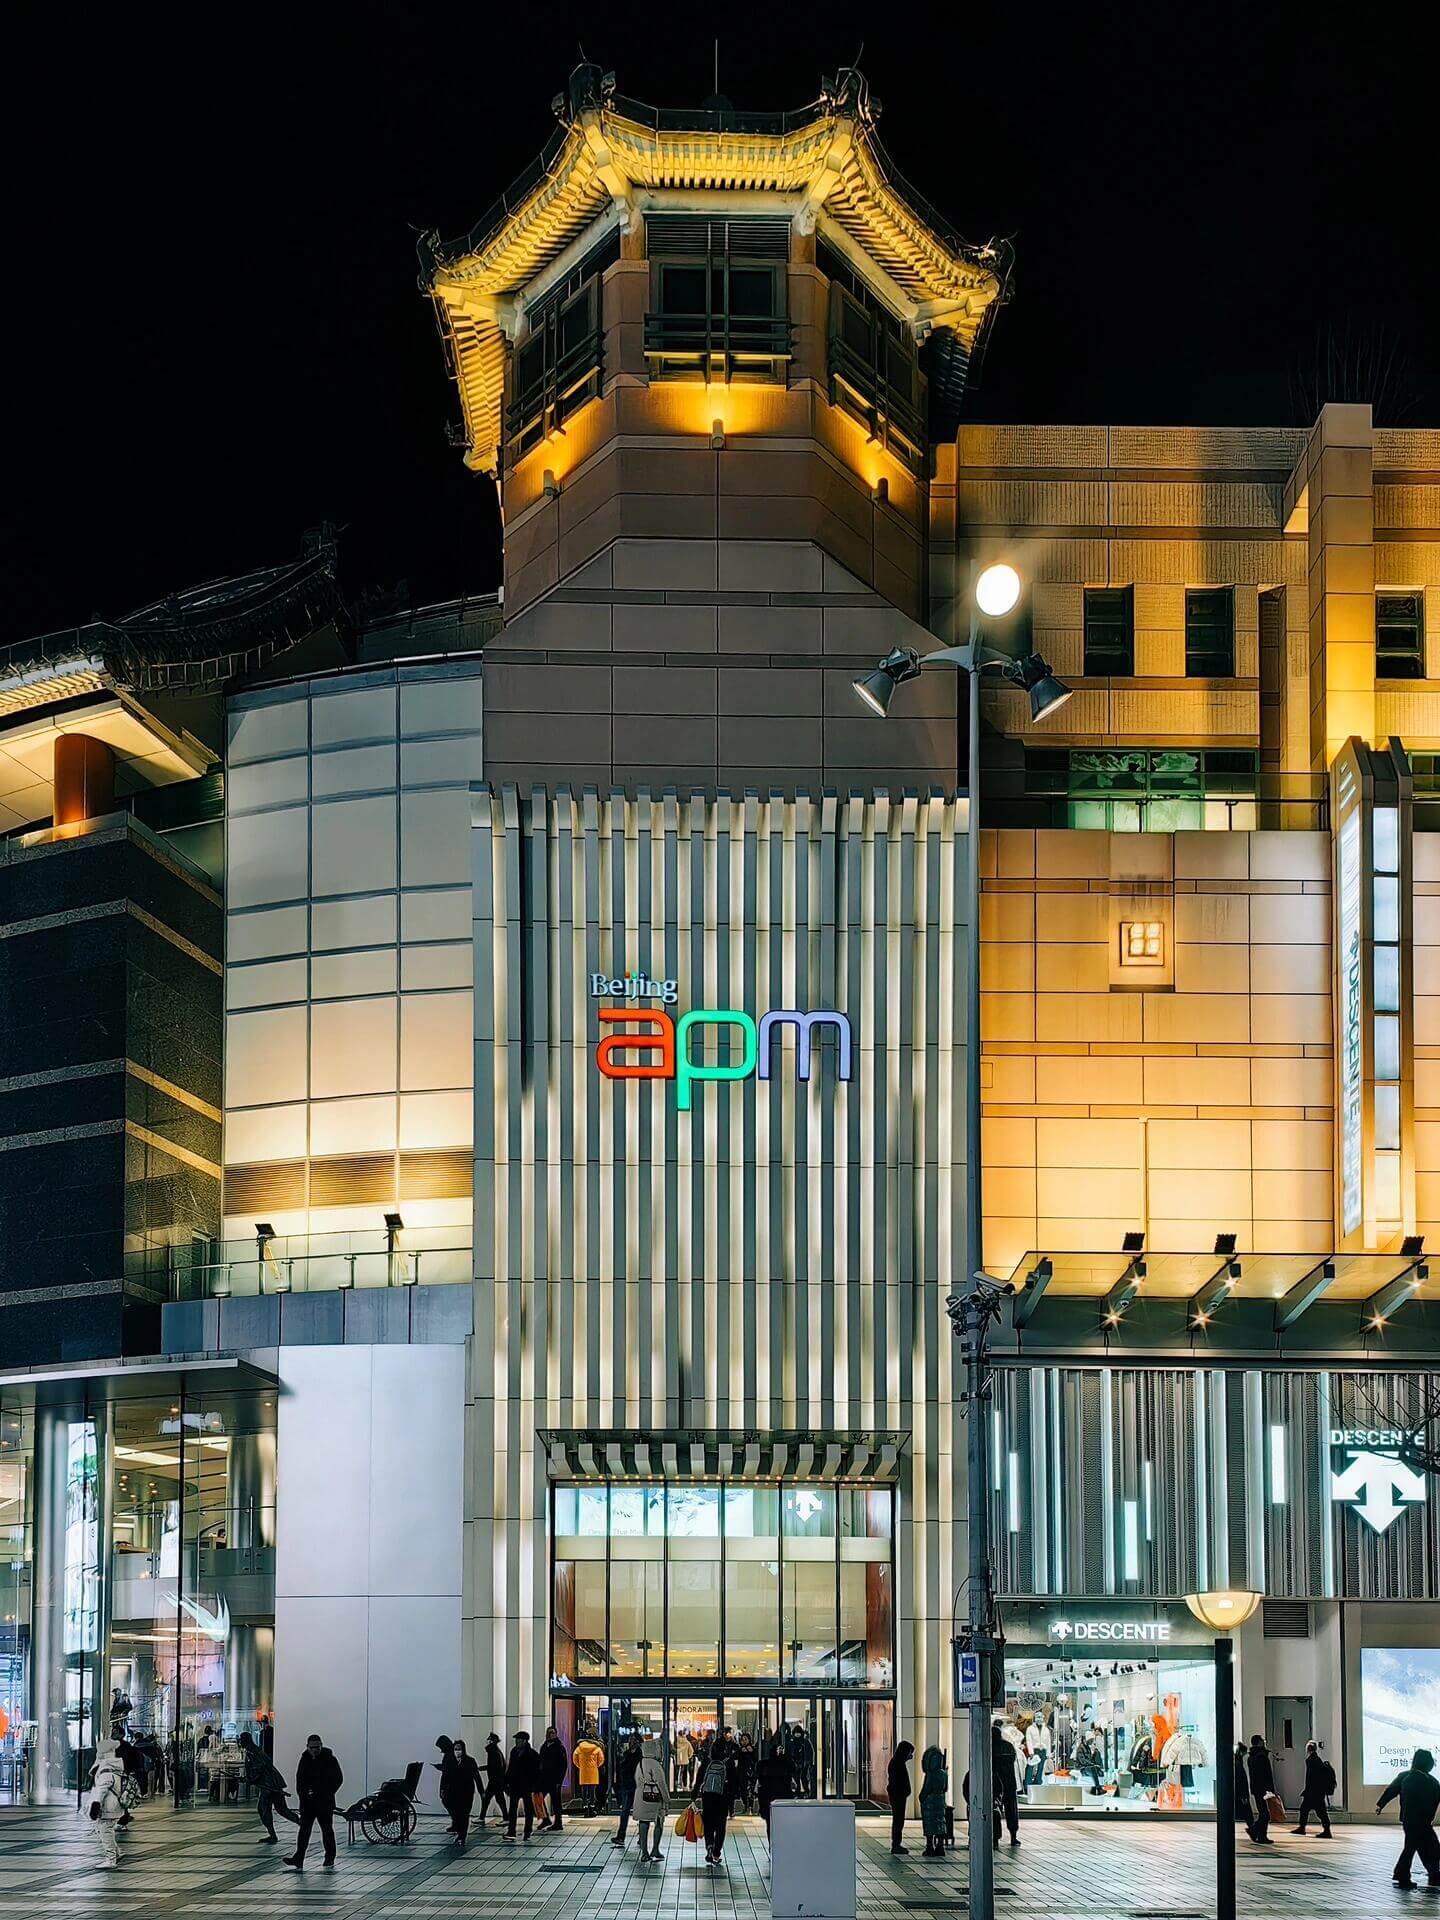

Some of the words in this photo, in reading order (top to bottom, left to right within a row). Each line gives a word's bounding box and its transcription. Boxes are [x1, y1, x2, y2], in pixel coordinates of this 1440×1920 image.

[590, 972, 678, 1004] Beijing
[1348, 960, 1360, 1121] DESCENTE
[596, 1007, 852, 1111] apm
[1074, 1622, 1170, 1640] DESCENTE
[1379, 1745, 1410, 1756] Design
